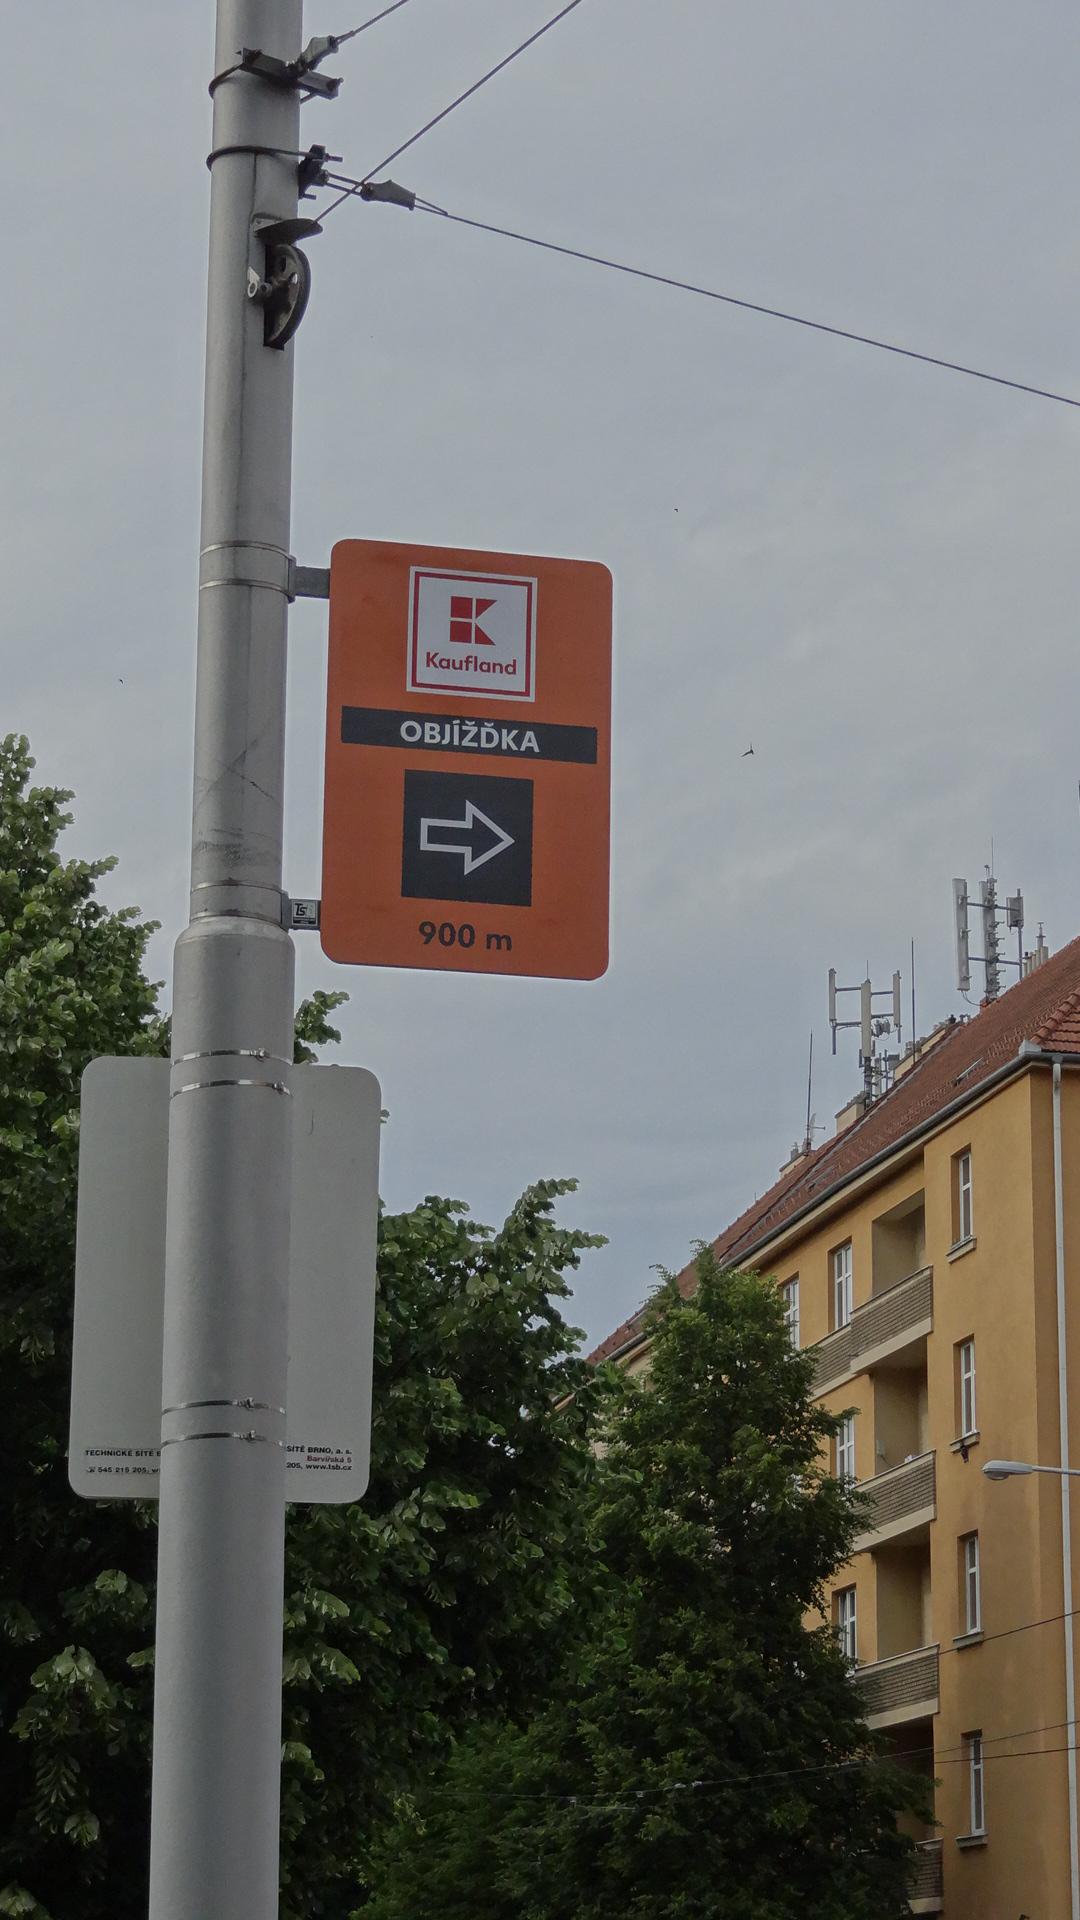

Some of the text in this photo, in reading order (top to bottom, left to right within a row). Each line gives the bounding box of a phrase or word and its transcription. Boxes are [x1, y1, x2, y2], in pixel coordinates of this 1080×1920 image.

[425, 651, 517, 676] Kaufland
[399, 719, 540, 753] OBJÍŽĎKA
[418, 921, 513, 951] 900 m
